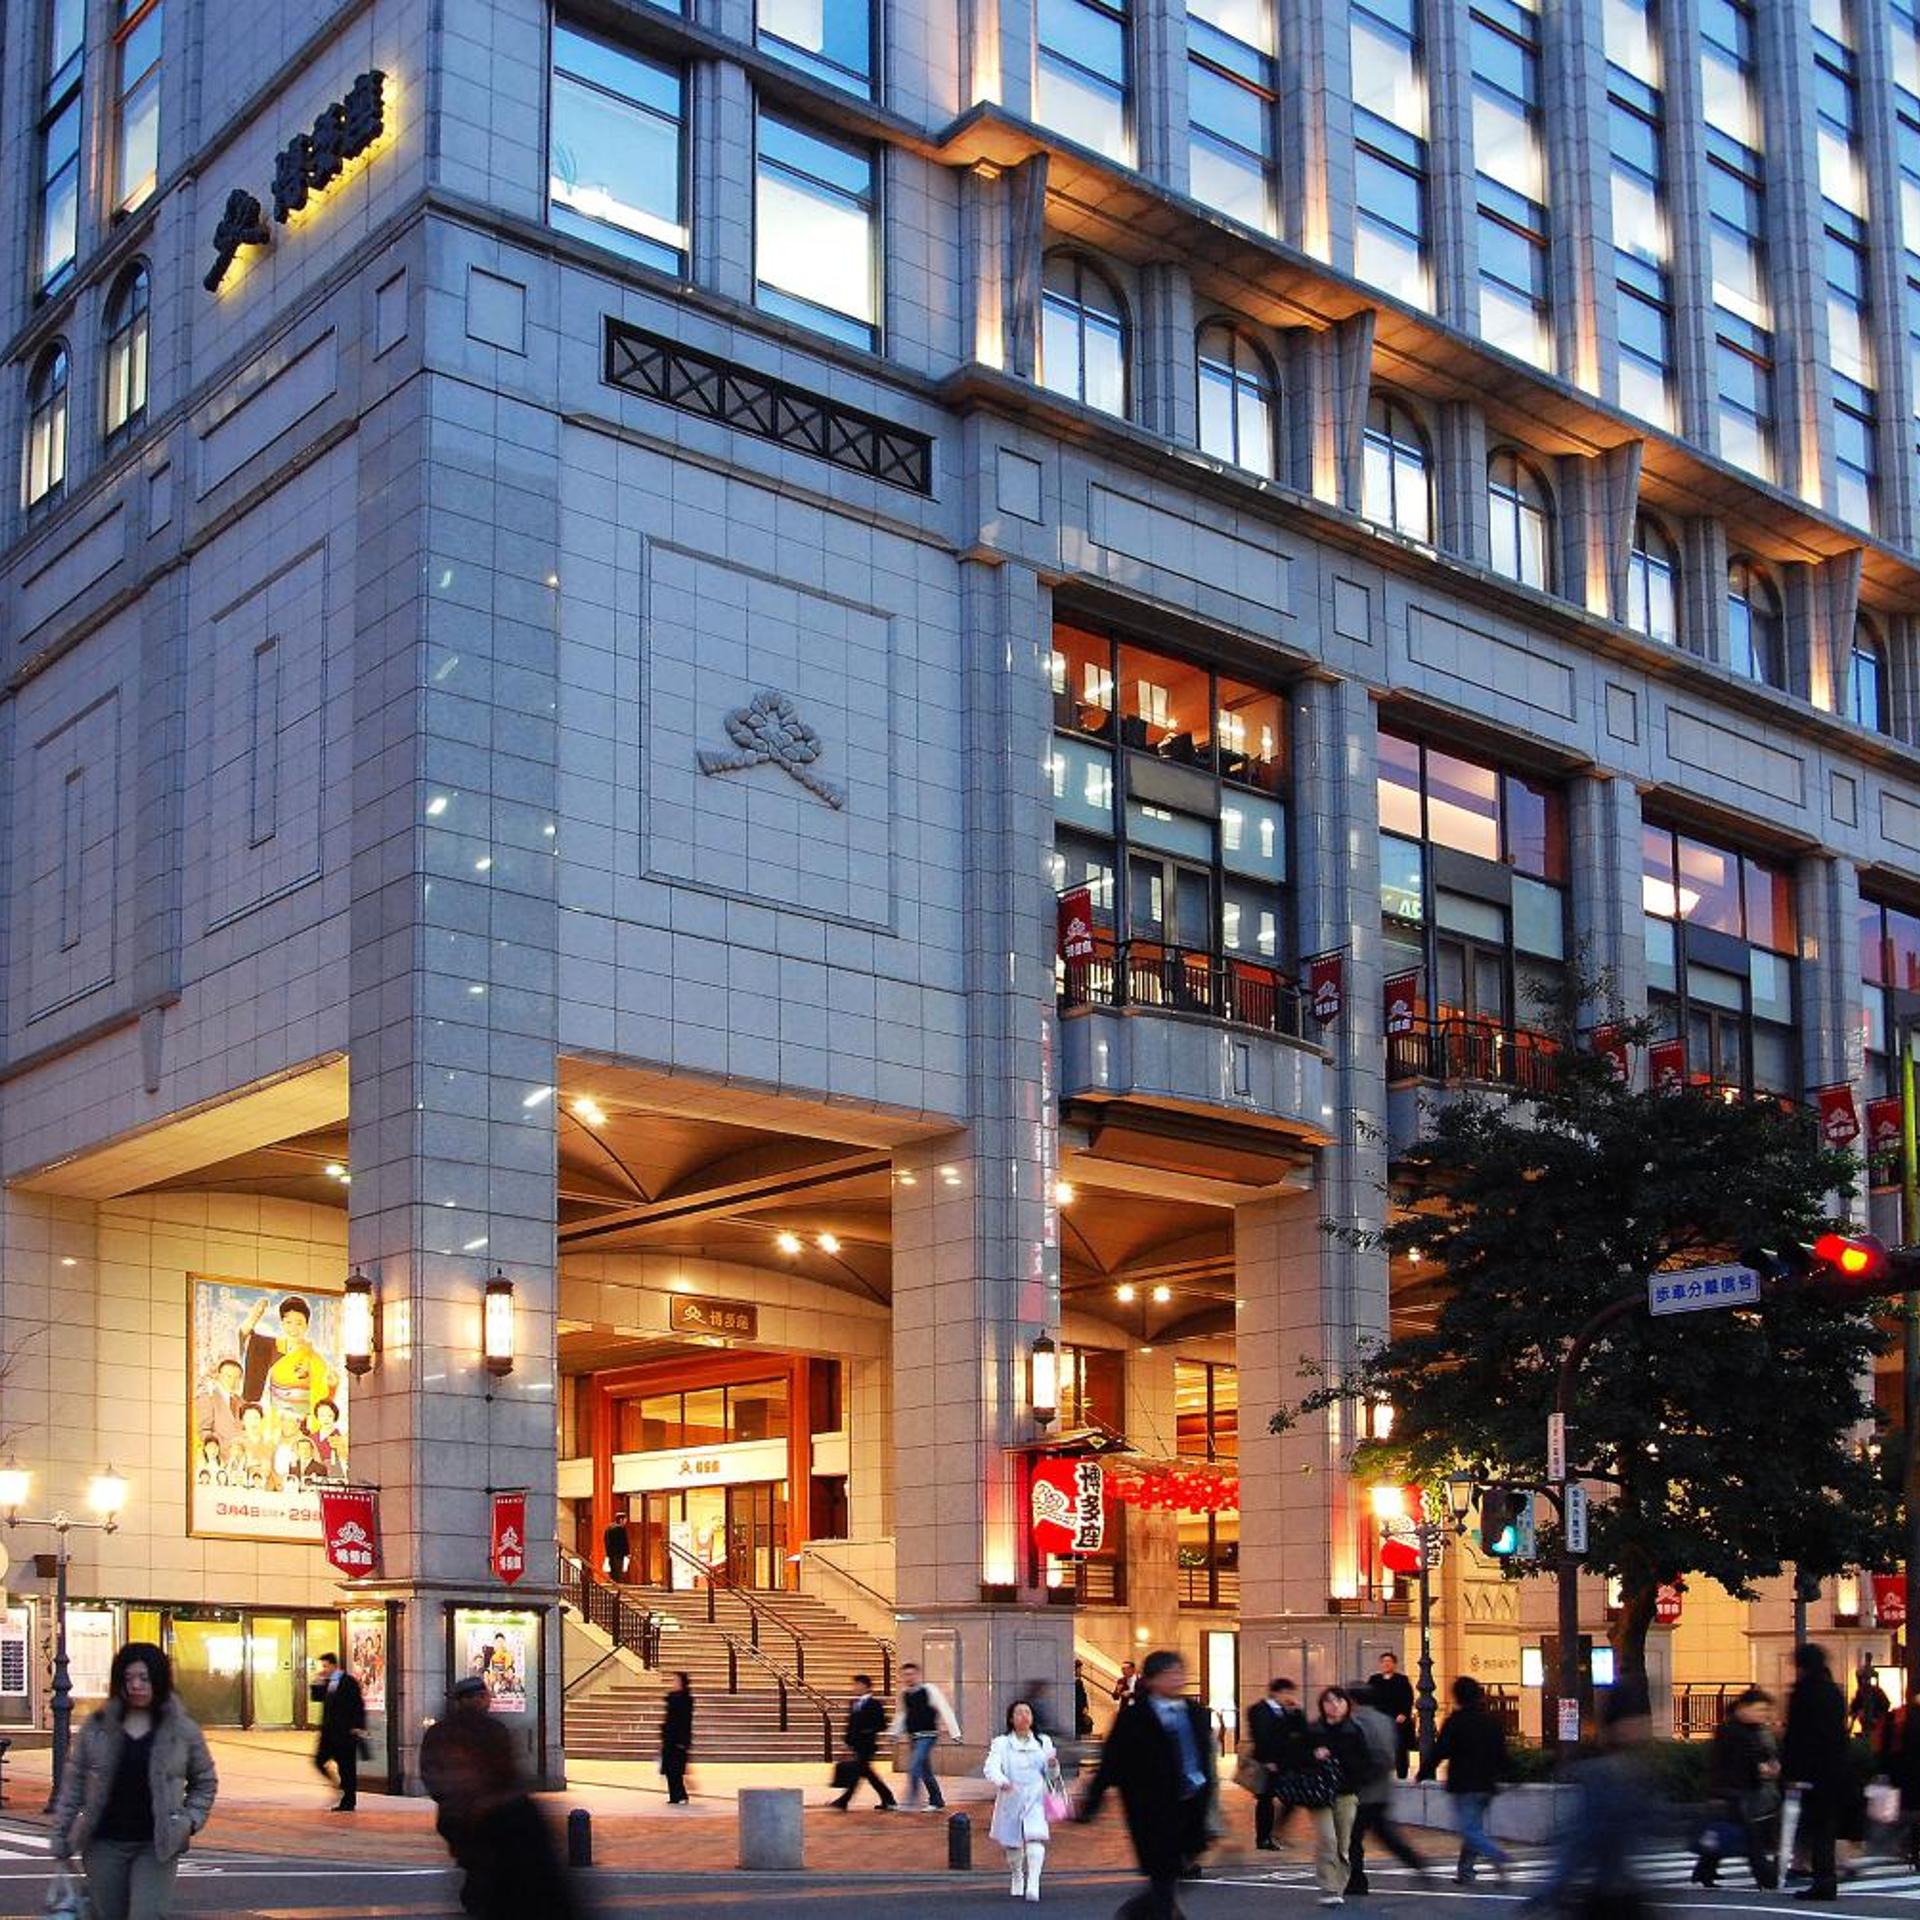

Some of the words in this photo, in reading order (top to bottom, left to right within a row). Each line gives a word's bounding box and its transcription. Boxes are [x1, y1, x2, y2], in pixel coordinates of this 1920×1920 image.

[1655, 1273, 1753, 1303] 歩車分離信号
[1076, 1463, 1102, 1549] 博多座
